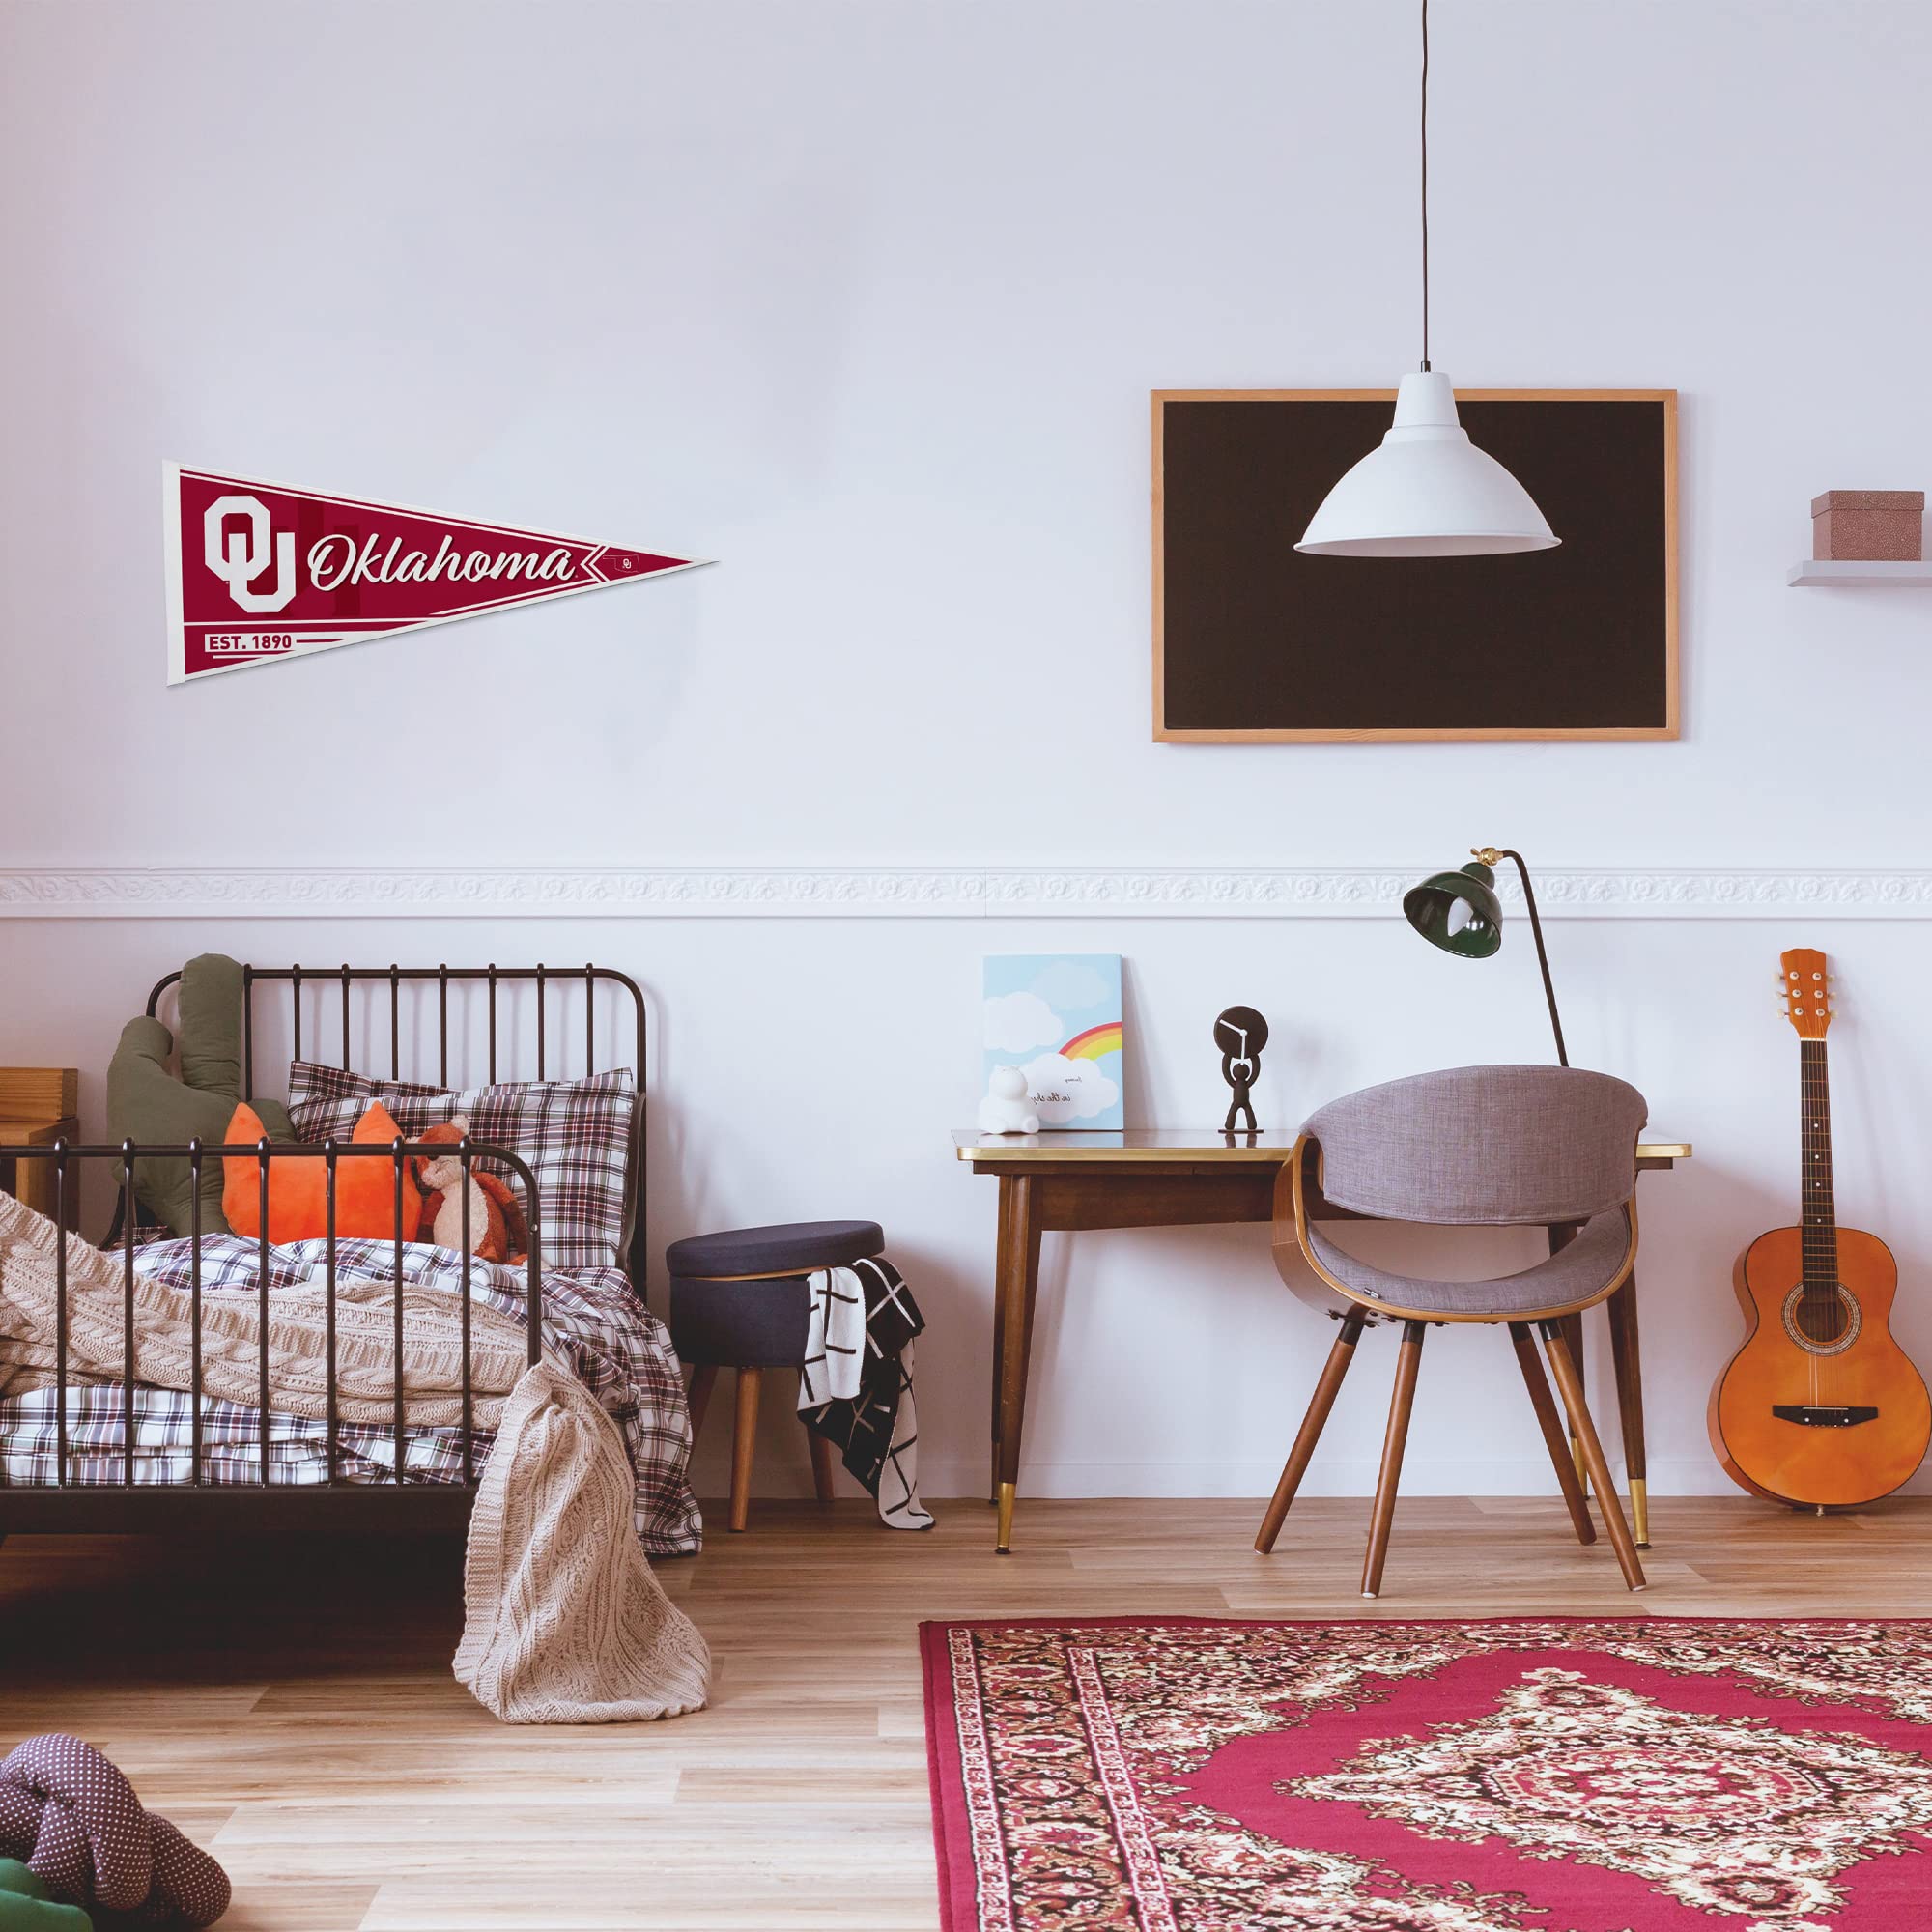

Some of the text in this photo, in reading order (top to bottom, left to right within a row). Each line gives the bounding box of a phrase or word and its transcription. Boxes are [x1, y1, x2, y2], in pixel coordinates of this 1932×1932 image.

[204, 495, 296, 613] OU
[307, 532, 576, 591] Oklahoma
[209, 634, 292, 650] EST. 1890
